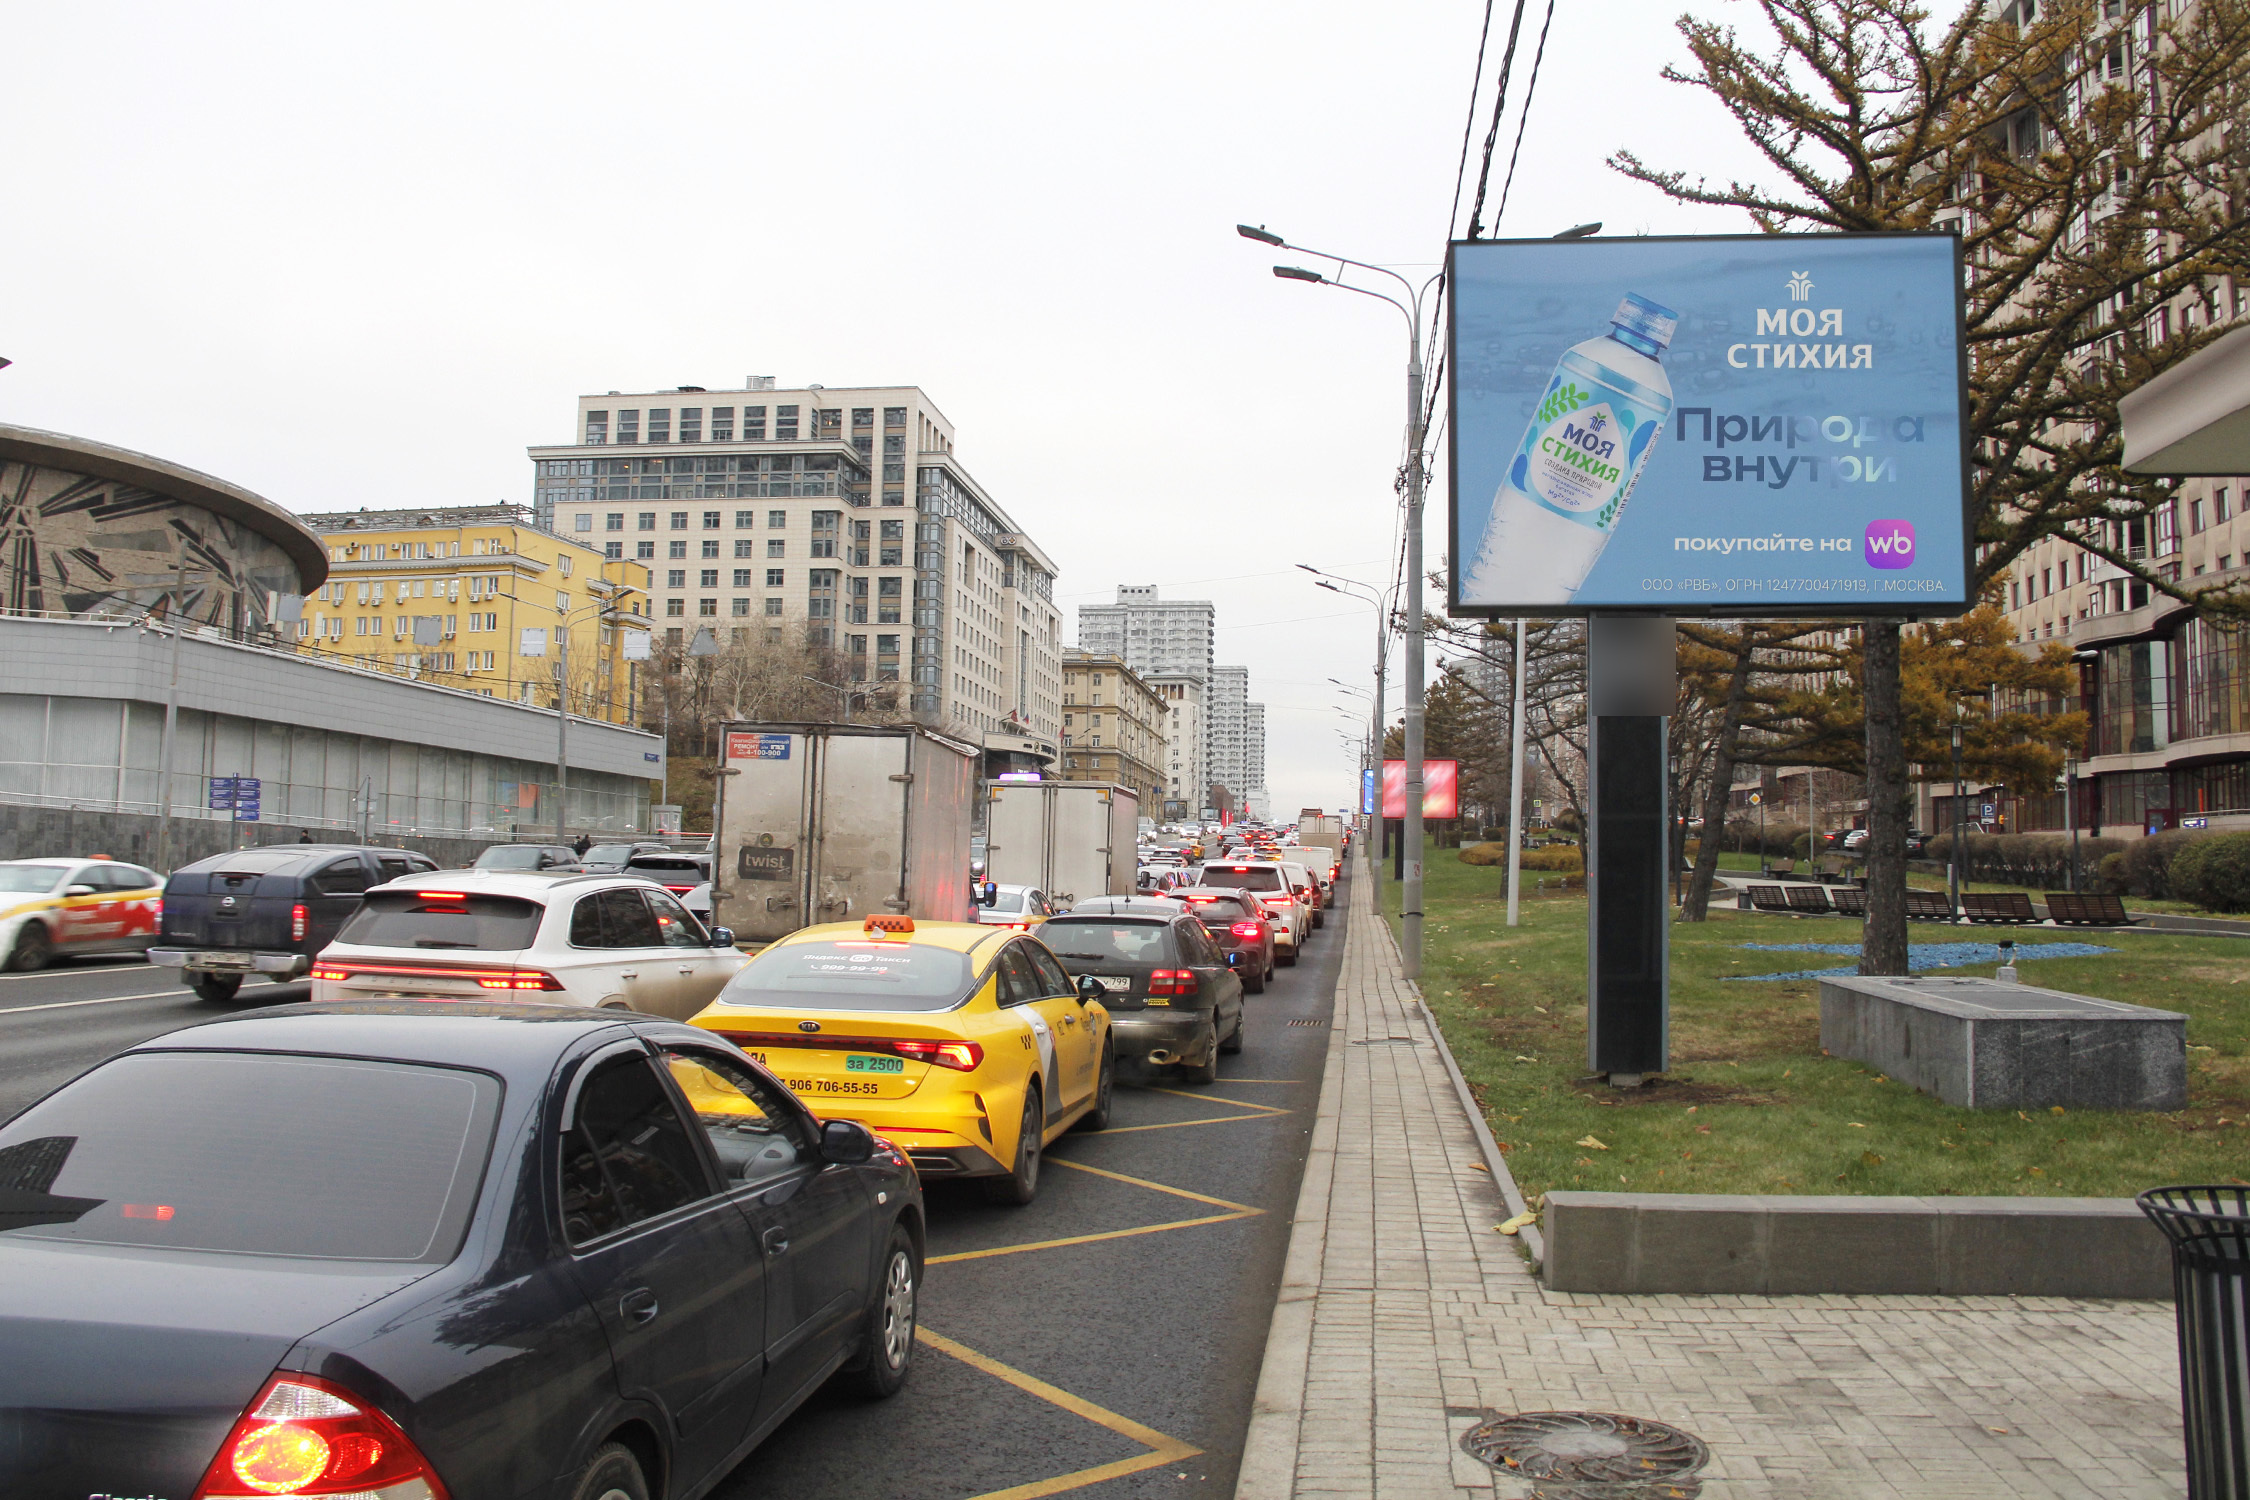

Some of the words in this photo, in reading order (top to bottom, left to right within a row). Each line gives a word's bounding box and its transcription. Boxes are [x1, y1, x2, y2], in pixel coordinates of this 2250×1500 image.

[1756, 308, 1843, 337] МОЯ
[1727, 343, 1873, 369] СТИХИЯ
[1676, 407, 1925, 449] Природа
[1562, 422, 1616, 460] МОЯ
[1541, 436, 1621, 484] СТИХИЯ
[1702, 455, 1897, 490] внутри
[1674, 533, 1814, 555] покупайте
[1820, 538, 1852, 551] на
[1868, 529, 1912, 555] wb
[1642, 579, 1673, 591] ООО
[1677, 579, 1722, 593] «РВБ»,
[1725, 579, 1763, 591] ОГРН
[1766, 579, 1870, 593] 1247700471919,
[1873, 579, 1948, 592] Г.МОСКВА.
[745, 853, 785, 869] twist
[802, 954, 849, 962] Яндекс
[875, 955, 911, 963] Такси
[820, 964, 888, 972] 999-99-99
[801, 1023, 817, 1031] KIA
[847, 1060, 864, 1069] за
[868, 1057, 904, 1072] 2500
[790, 1079, 812, 1091] 906
[816, 1080, 878, 1095] 706-55-55
